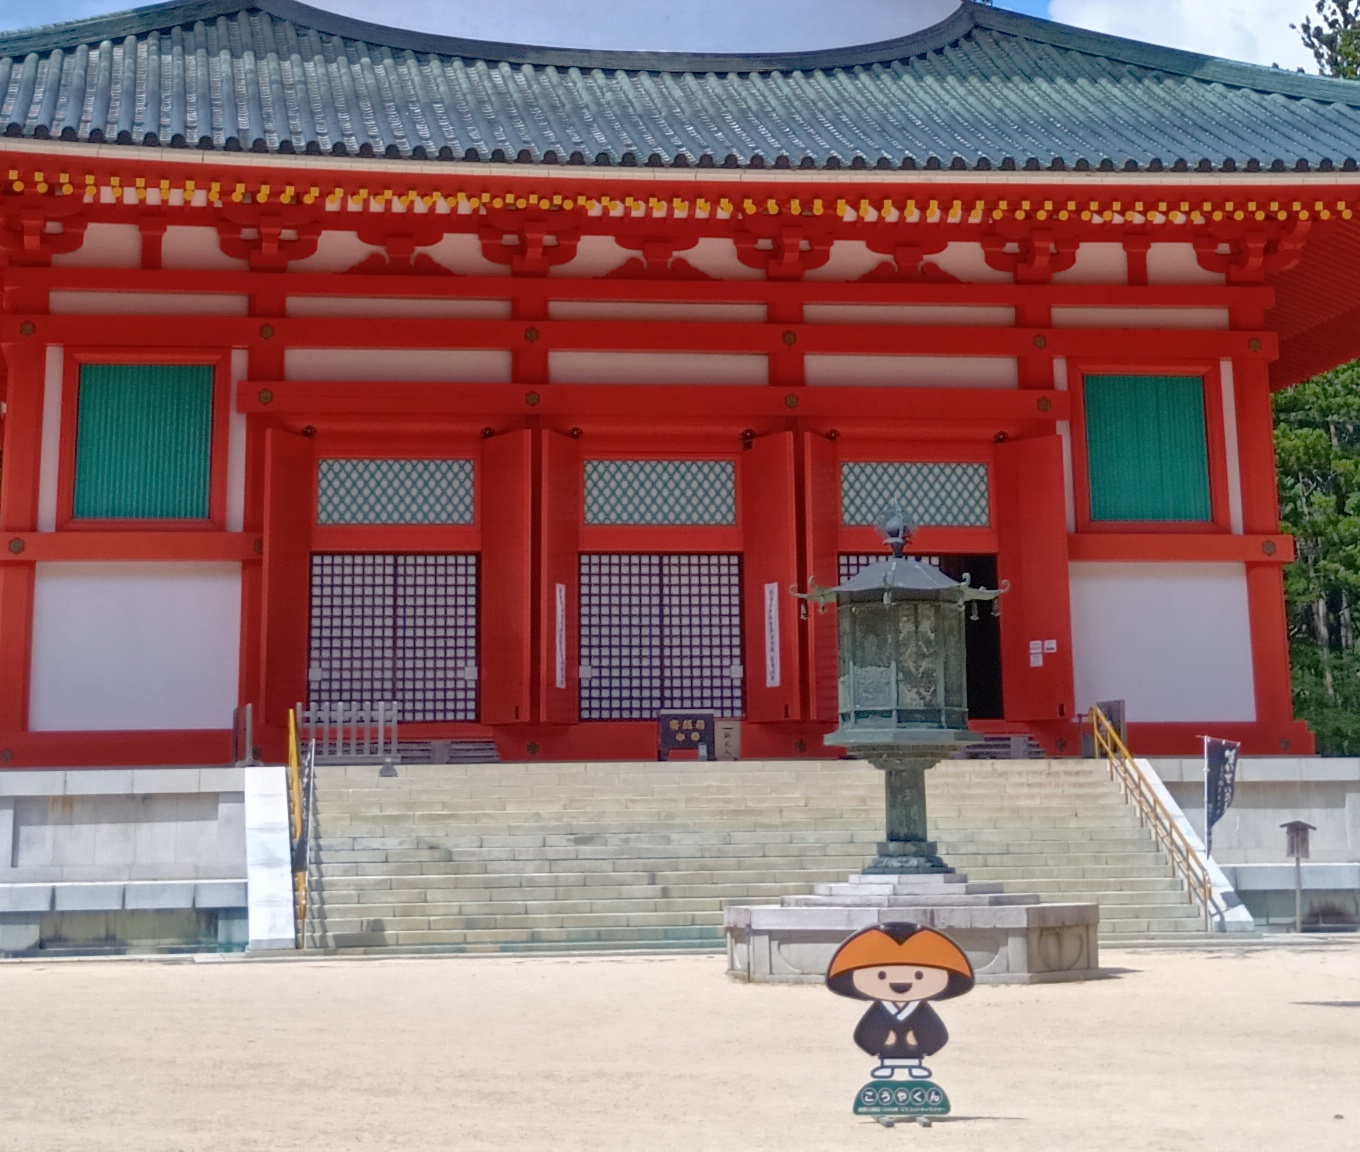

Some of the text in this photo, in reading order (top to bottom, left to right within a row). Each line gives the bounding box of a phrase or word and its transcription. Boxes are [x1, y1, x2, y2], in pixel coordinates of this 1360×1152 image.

[863, 1090, 940, 1103] こうやくん
